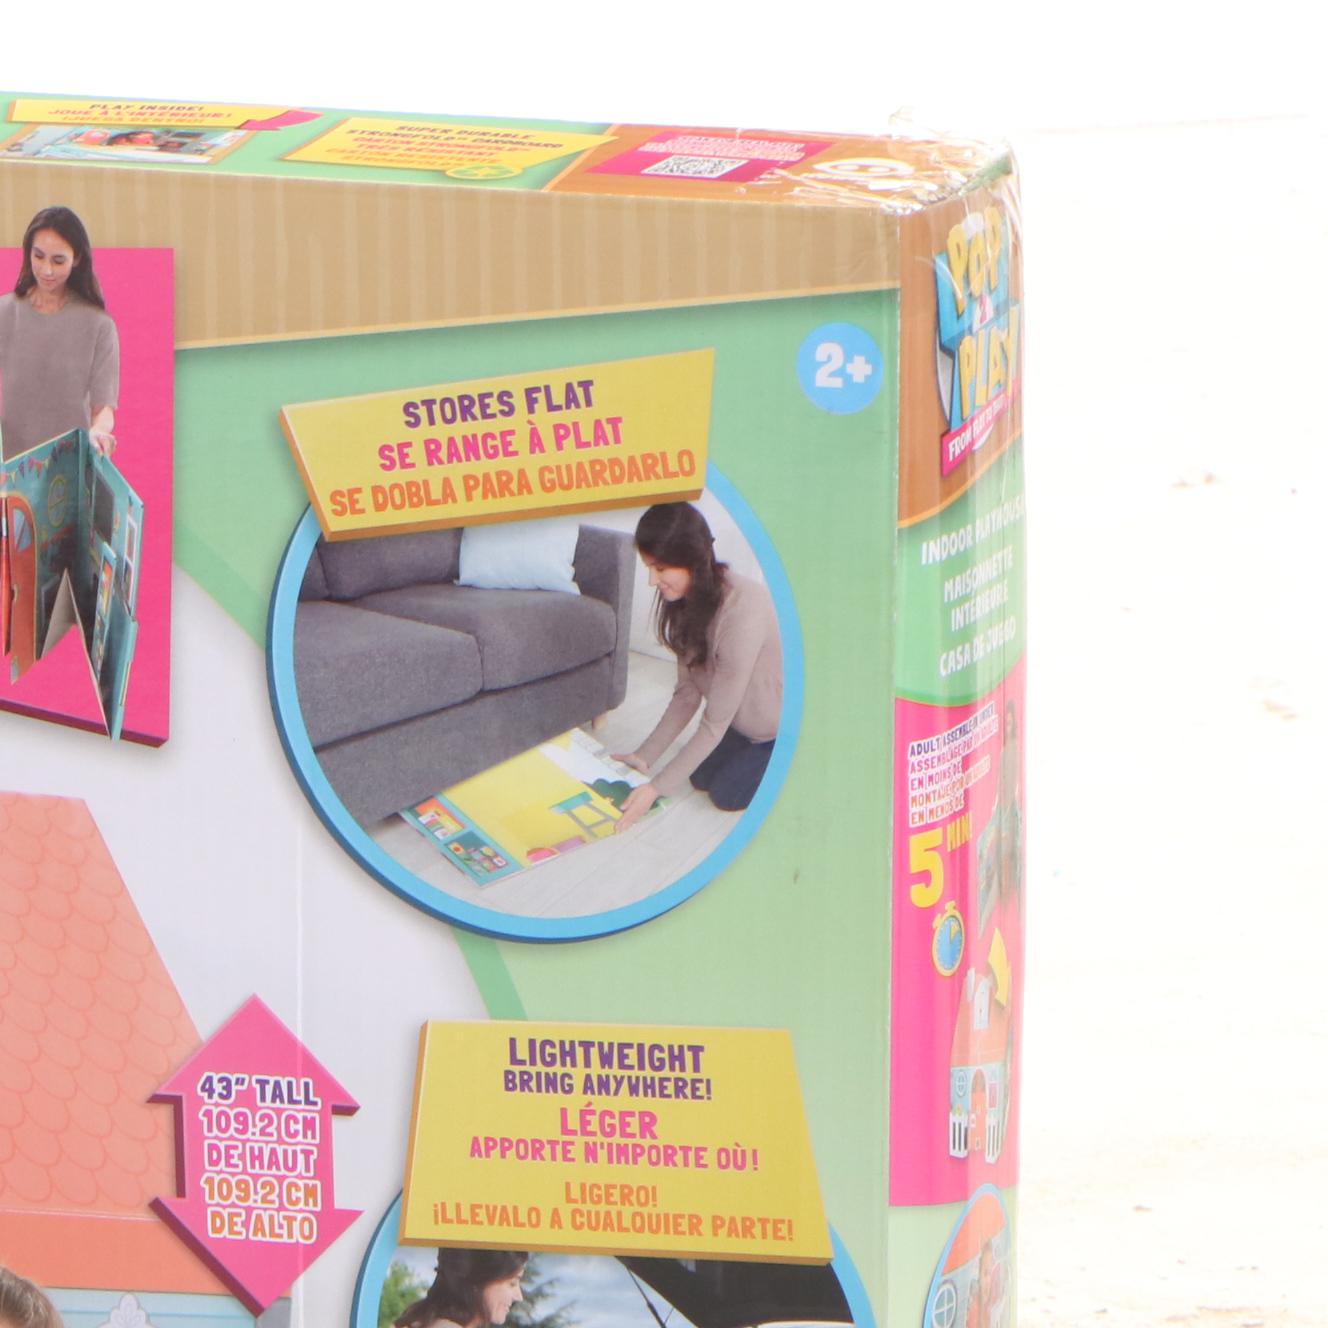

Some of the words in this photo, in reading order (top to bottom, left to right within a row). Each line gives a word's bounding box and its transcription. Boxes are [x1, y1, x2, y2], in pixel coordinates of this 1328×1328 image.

[814, 342, 873, 388] 2+
[403, 390, 515, 428] STORES
[525, 380, 594, 414] FLAT
[378, 441, 416, 471] SE
[424, 429, 520, 466] RANGE
[528, 419, 546, 454] À
[554, 416, 624, 451] PLAT
[330, 488, 364, 516] SE
[372, 477, 457, 512] DOBLA
[465, 468, 532, 503] PARA
[538, 448, 696, 493] GUARDARLO
[508, 1037, 705, 1073] LIGHTWEIGHT
[255, 1079, 318, 1106] TALL
[504, 1070, 574, 1095] BRING
[583, 1074, 712, 1100] ANYWHERE!
[202, 1109, 275, 1137] 109.2
[284, 1113, 317, 1141] CM
[560, 1102, 658, 1140] LÉGER
[207, 1143, 241, 1169] DE
[250, 1147, 316, 1173] HAUT
[470, 1136, 576, 1163] APPORTE
[584, 1140, 708, 1169] N'IMPORTE
[204, 1177, 278, 1205] 109.2
[285, 1182, 318, 1208] CM
[564, 1182, 657, 1207] LIGERO!
[211, 1210, 244, 1236] DE
[253, 1213, 315, 1240] ALTO
[433, 1202, 541, 1228] ¡LLEVALO
[550, 1208, 563, 1230] A
[571, 1210, 703, 1236] CUALQUIER
[712, 1216, 794, 1241] PARTE!
